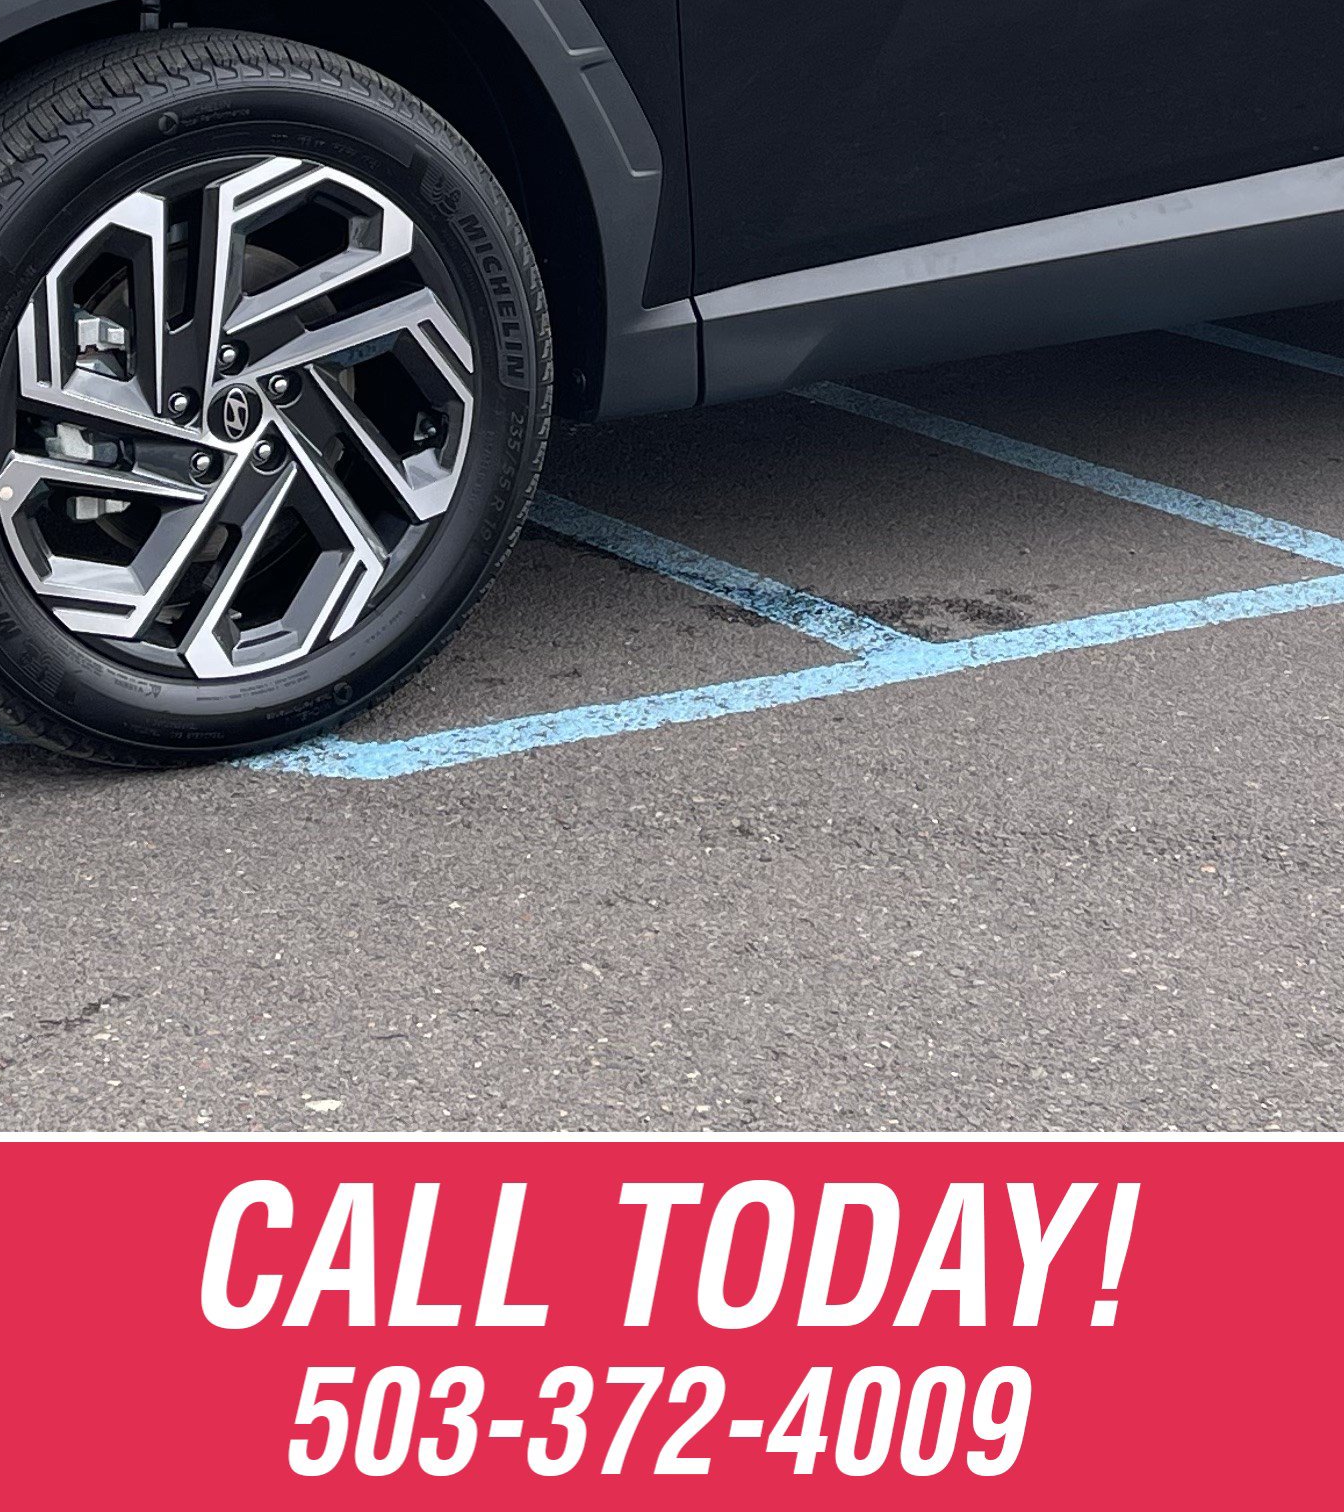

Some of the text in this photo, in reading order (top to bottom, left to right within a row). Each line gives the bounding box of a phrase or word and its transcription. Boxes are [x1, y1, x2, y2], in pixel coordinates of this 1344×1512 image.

[458, 212, 525, 379] MICHELIN
[500, 411, 525, 491] 235/55
[491, 495, 506, 513] R
